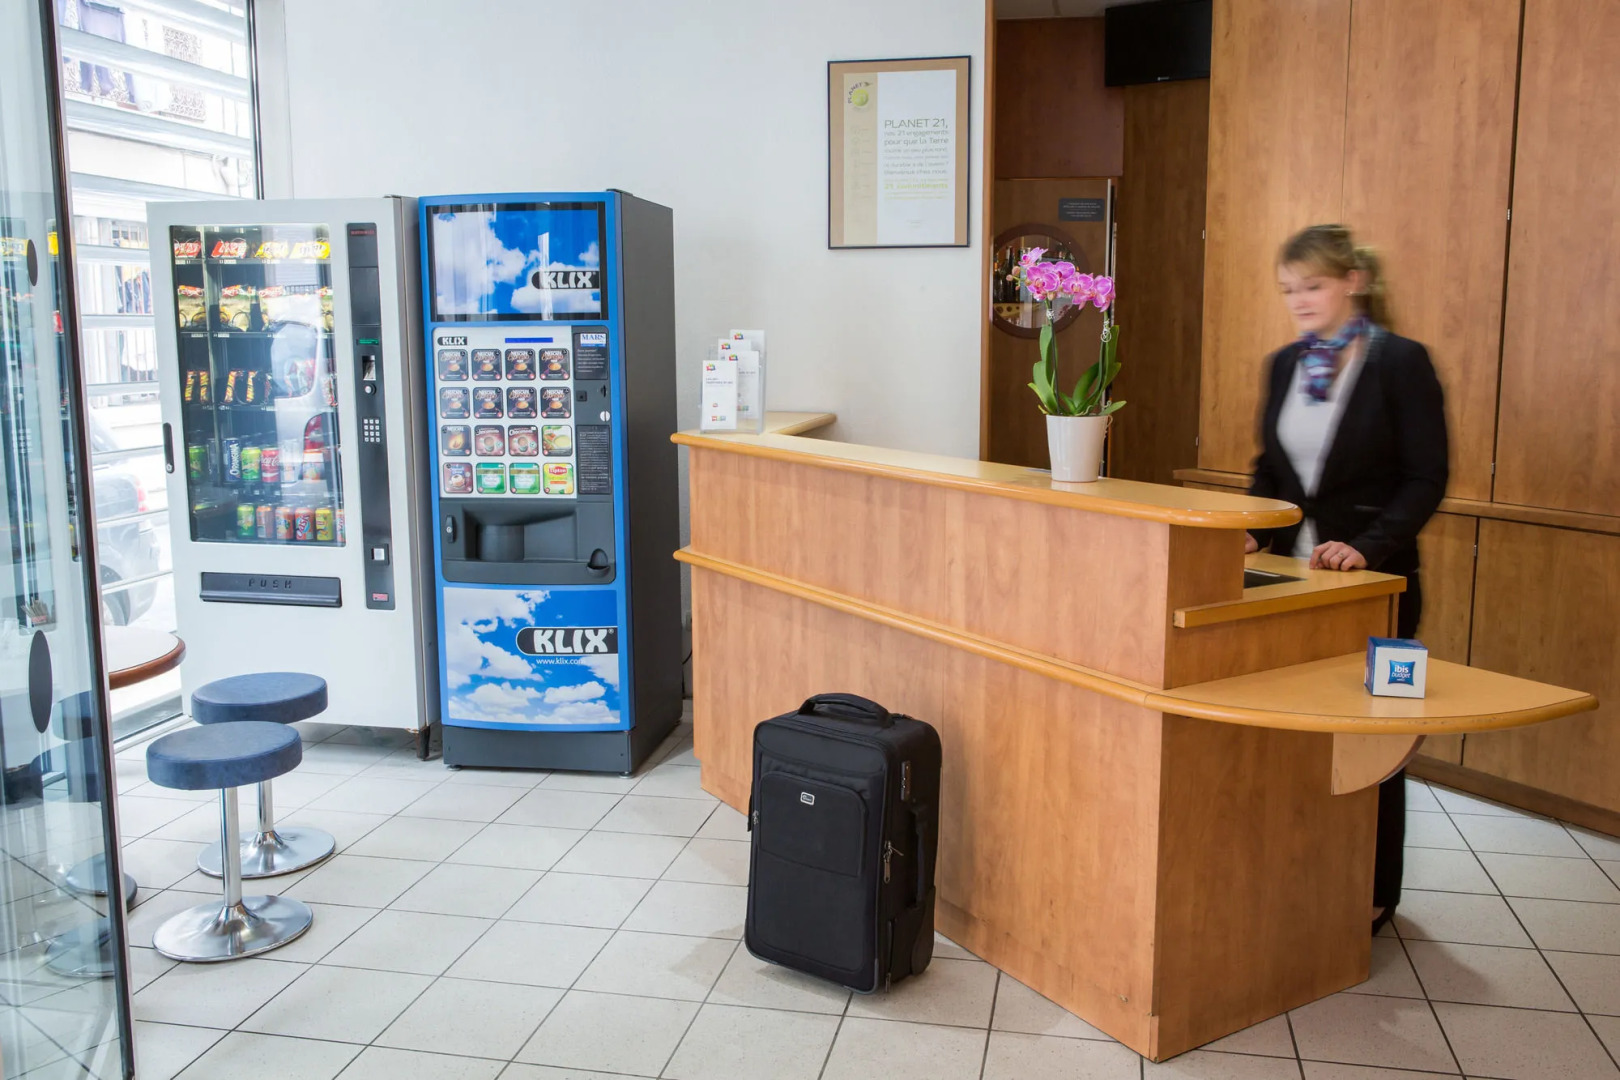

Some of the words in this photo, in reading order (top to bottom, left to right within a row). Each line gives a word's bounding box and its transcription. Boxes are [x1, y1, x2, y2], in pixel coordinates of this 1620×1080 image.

[884, 119, 930, 129] PLANET
[932, 118, 948, 129] 21,
[884, 138, 901, 146] pour
[903, 138, 918, 147] que
[919, 137, 927, 145] la
[542, 270, 593, 289] KLIX
[441, 337, 466, 346] KLIX
[248, 578, 293, 589] PUSH
[533, 629, 609, 653] KLIX
[1394, 665, 1409, 673] ibis
